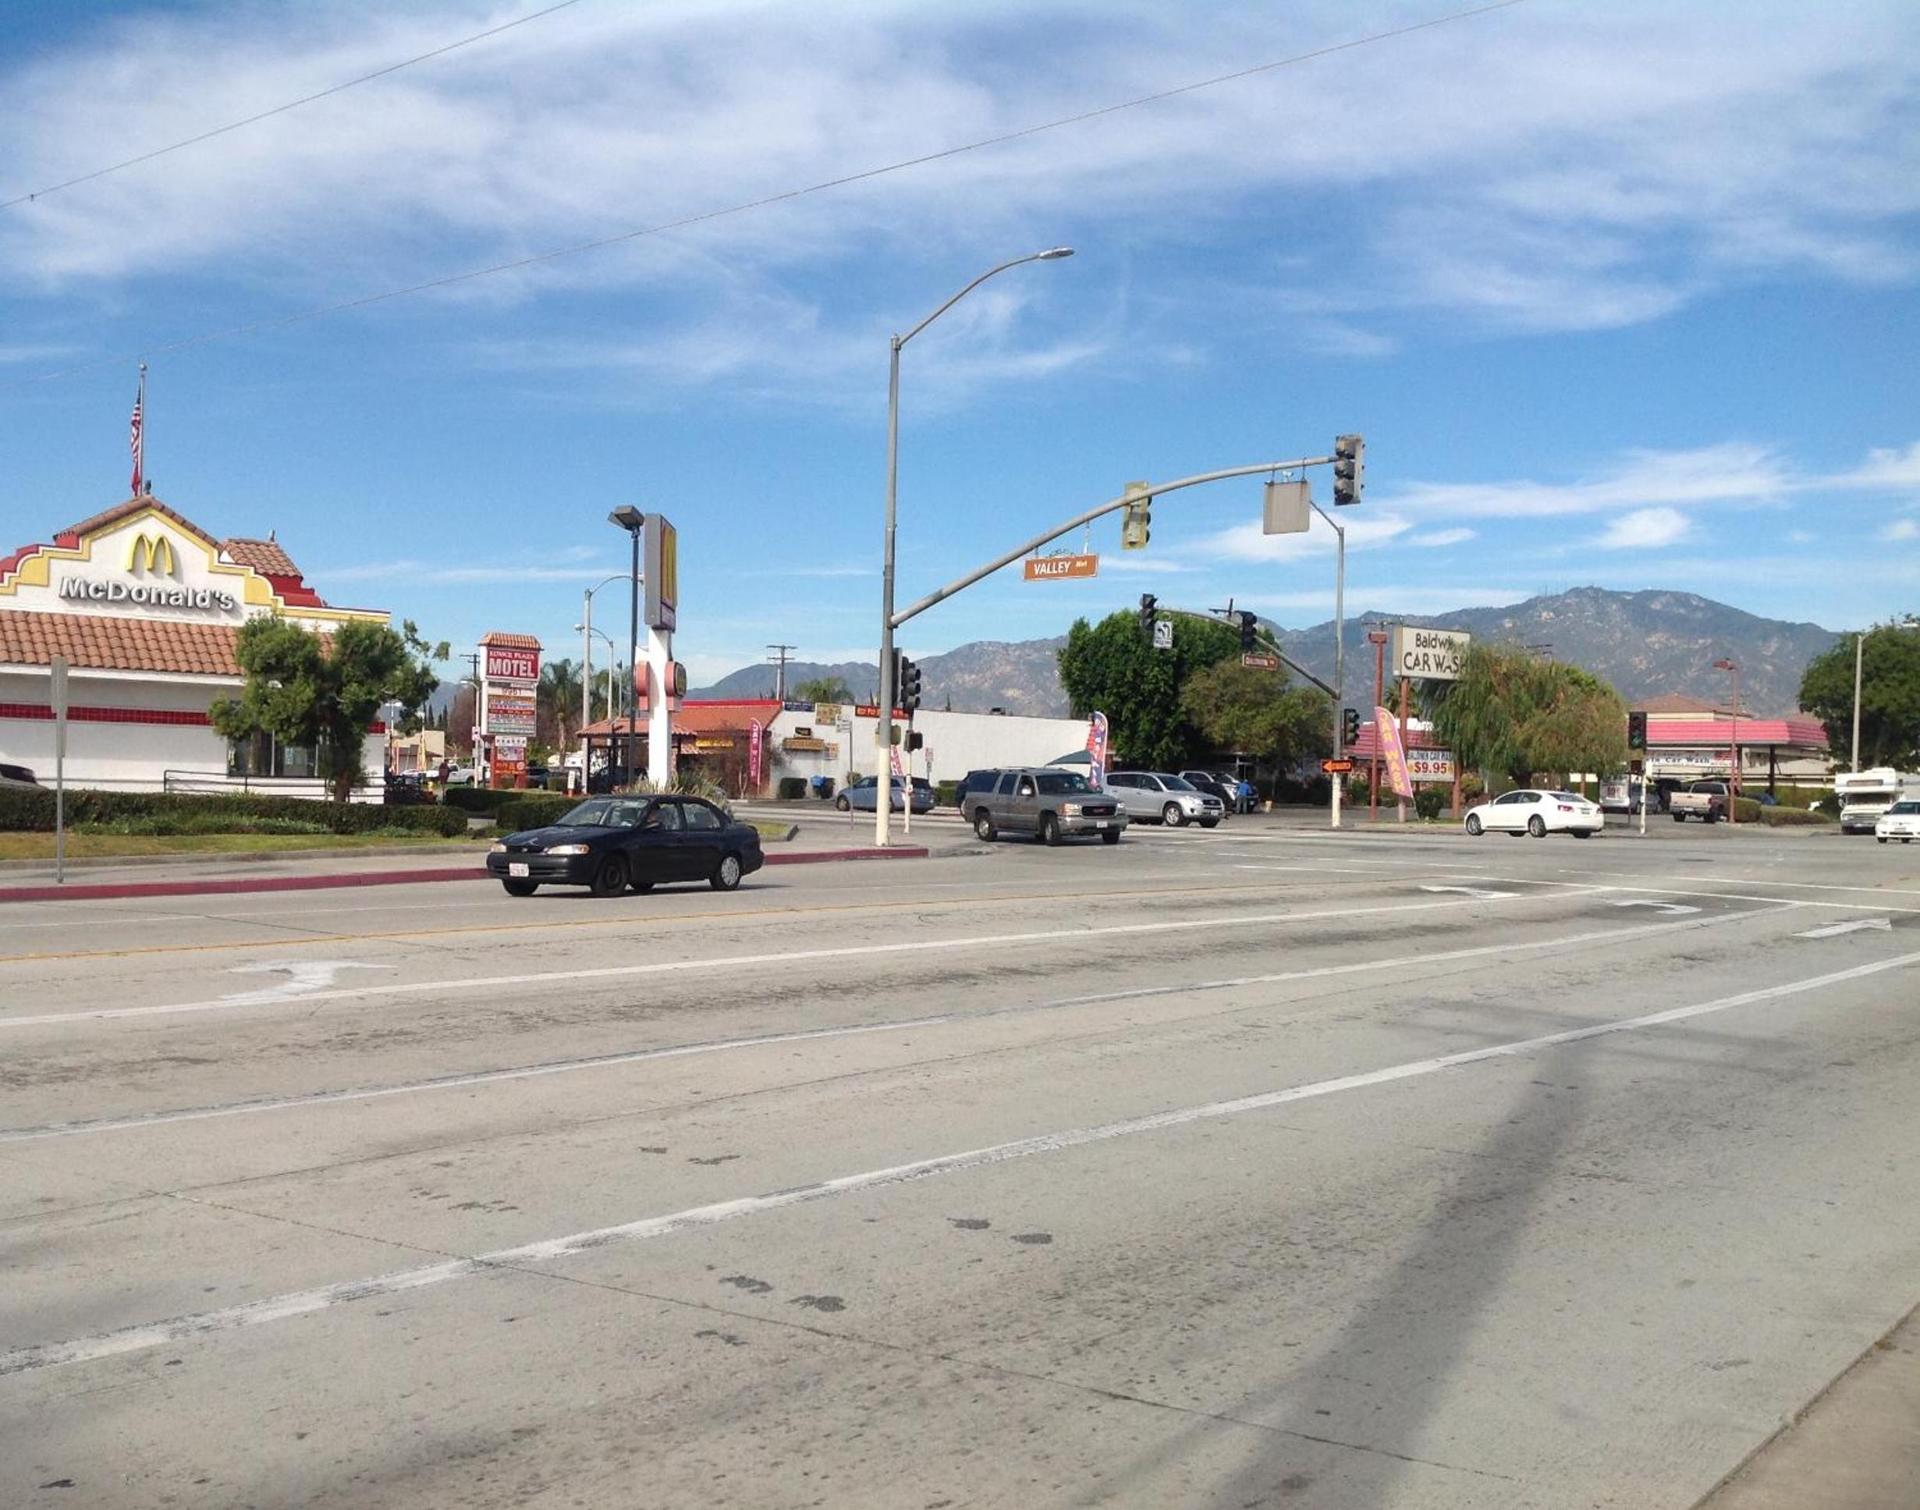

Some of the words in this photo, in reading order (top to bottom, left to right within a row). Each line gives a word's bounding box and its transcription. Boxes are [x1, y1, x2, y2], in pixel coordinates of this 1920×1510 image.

[1034, 561, 1071, 575] VALLEY
[59, 575, 235, 610] McDonald's
[1415, 632, 1454, 650] Baldwi
[489, 658, 535, 677] MOTEL
[1403, 651, 1431, 672] CAR
[1414, 761, 1447, 774] $9.95
[1686, 756, 1710, 764] Wash
